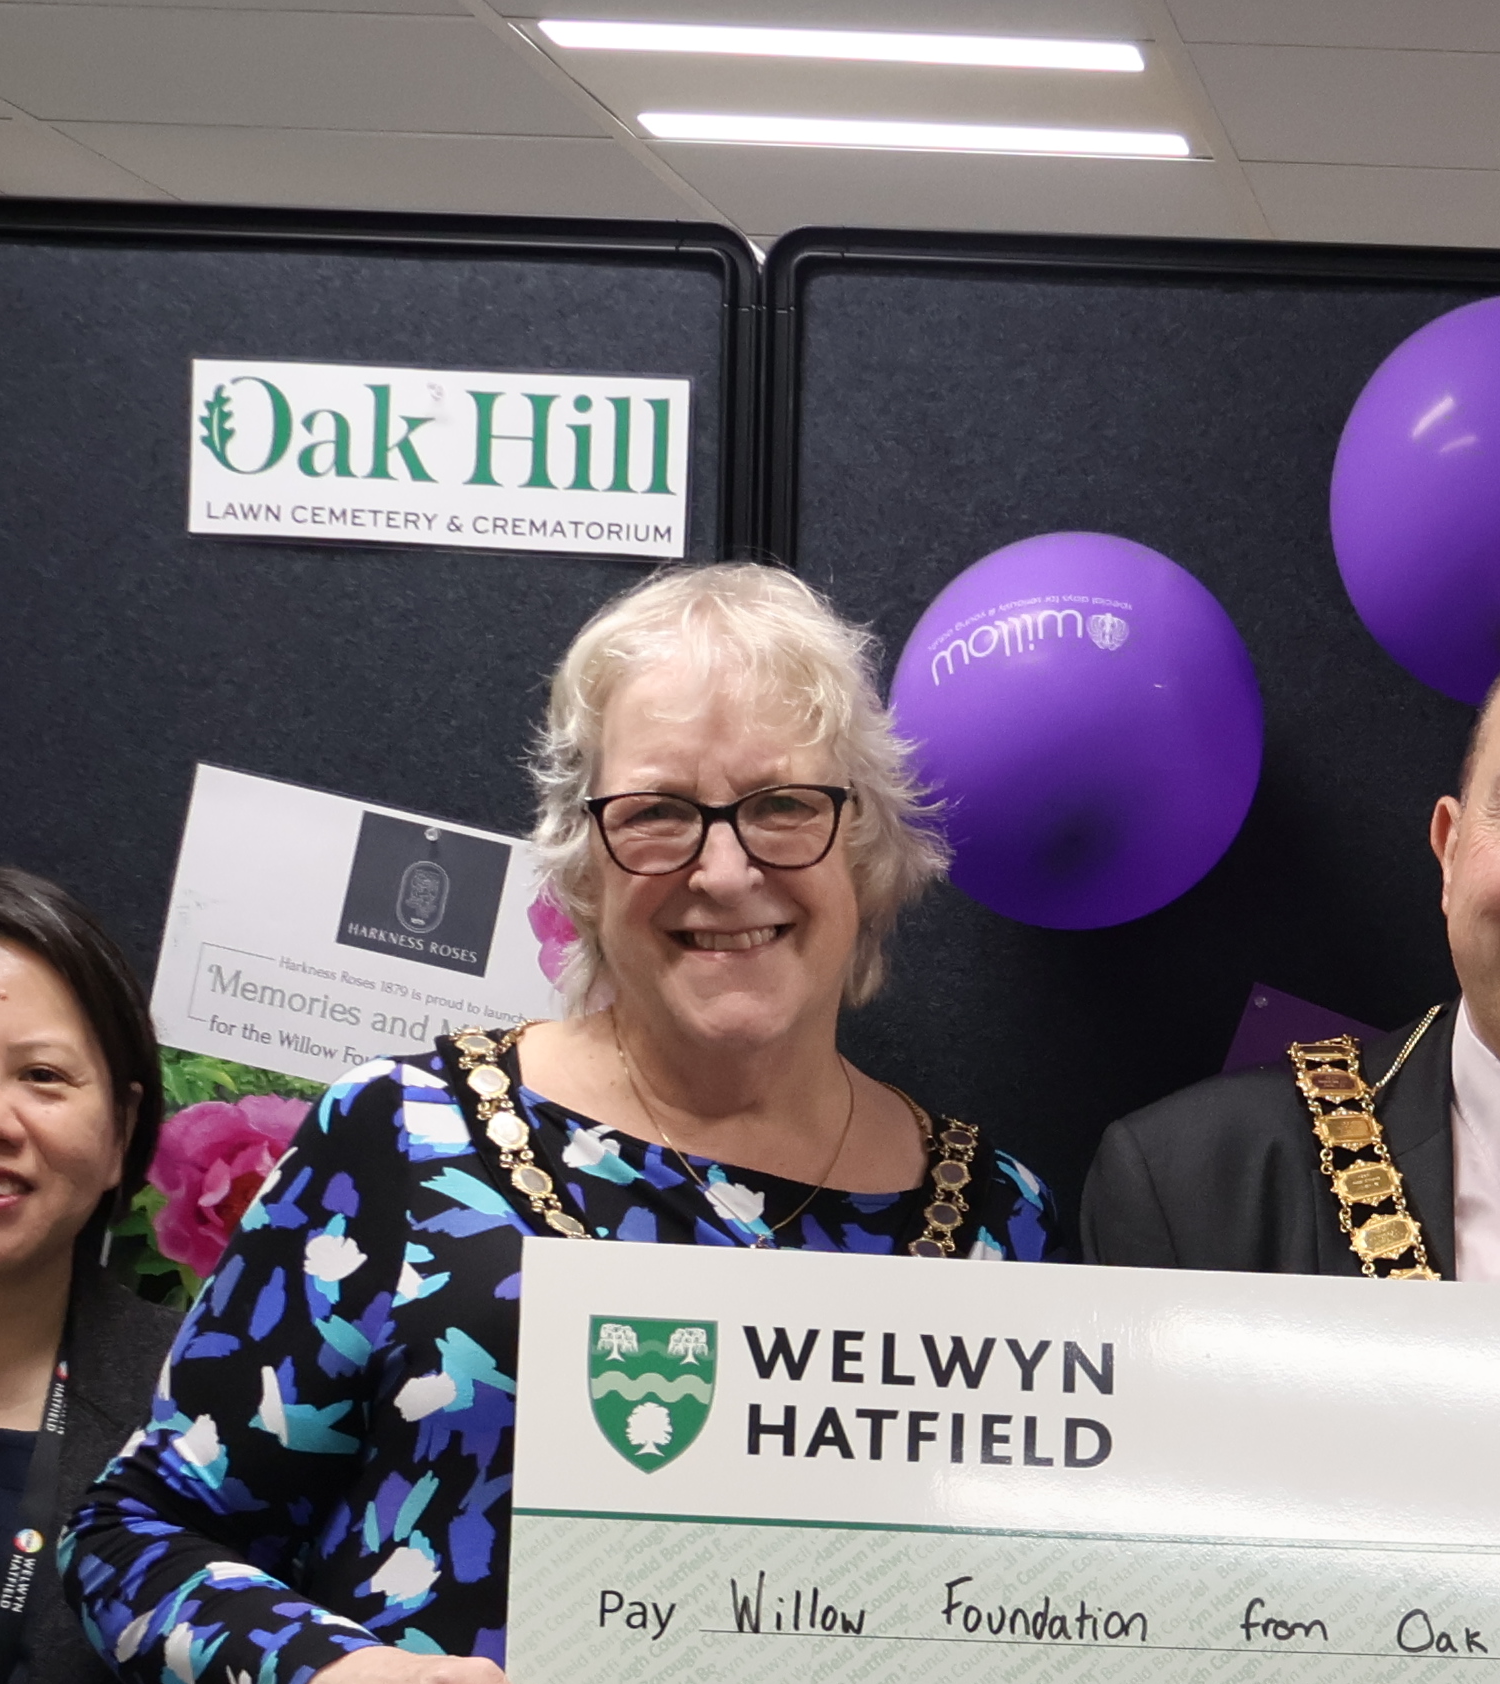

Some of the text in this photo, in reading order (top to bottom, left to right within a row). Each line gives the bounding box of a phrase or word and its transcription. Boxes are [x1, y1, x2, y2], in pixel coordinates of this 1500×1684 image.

[199, 375, 677, 495] Oak Hill
[206, 501, 673, 543] LAWN CEMETERY & CREMATORIUM
[931, 609, 1083, 686] willow
[347, 923, 478, 963] HARKNESS ROSES
[279, 956, 337, 981] Harkness
[341, 970, 376, 991] Roses
[380, 980, 409, 998] 1879
[412, 988, 421, 1001] is
[425, 994, 464, 1013] proud
[467, 1002, 481, 1015] to
[208, 1015, 238, 1037] for
[241, 1024, 272, 1045] the
[278, 1029, 338, 1059] Willow
[370, 1009, 430, 1042] and
[742, 1325, 1114, 1396] WELWYN
[747, 1404, 1114, 1470] HATFIELD
[0, 1554, 24, 1609] HATFIELD
[13, 1558, 36, 1613] WELWYN
[600, 1590, 676, 1641] Pay
[730, 1570, 864, 1635] Willow
[942, 1576, 1148, 1642] Foundation
[1240, 1597, 1329, 1642] from
[1396, 1608, 1489, 1653] Oak
